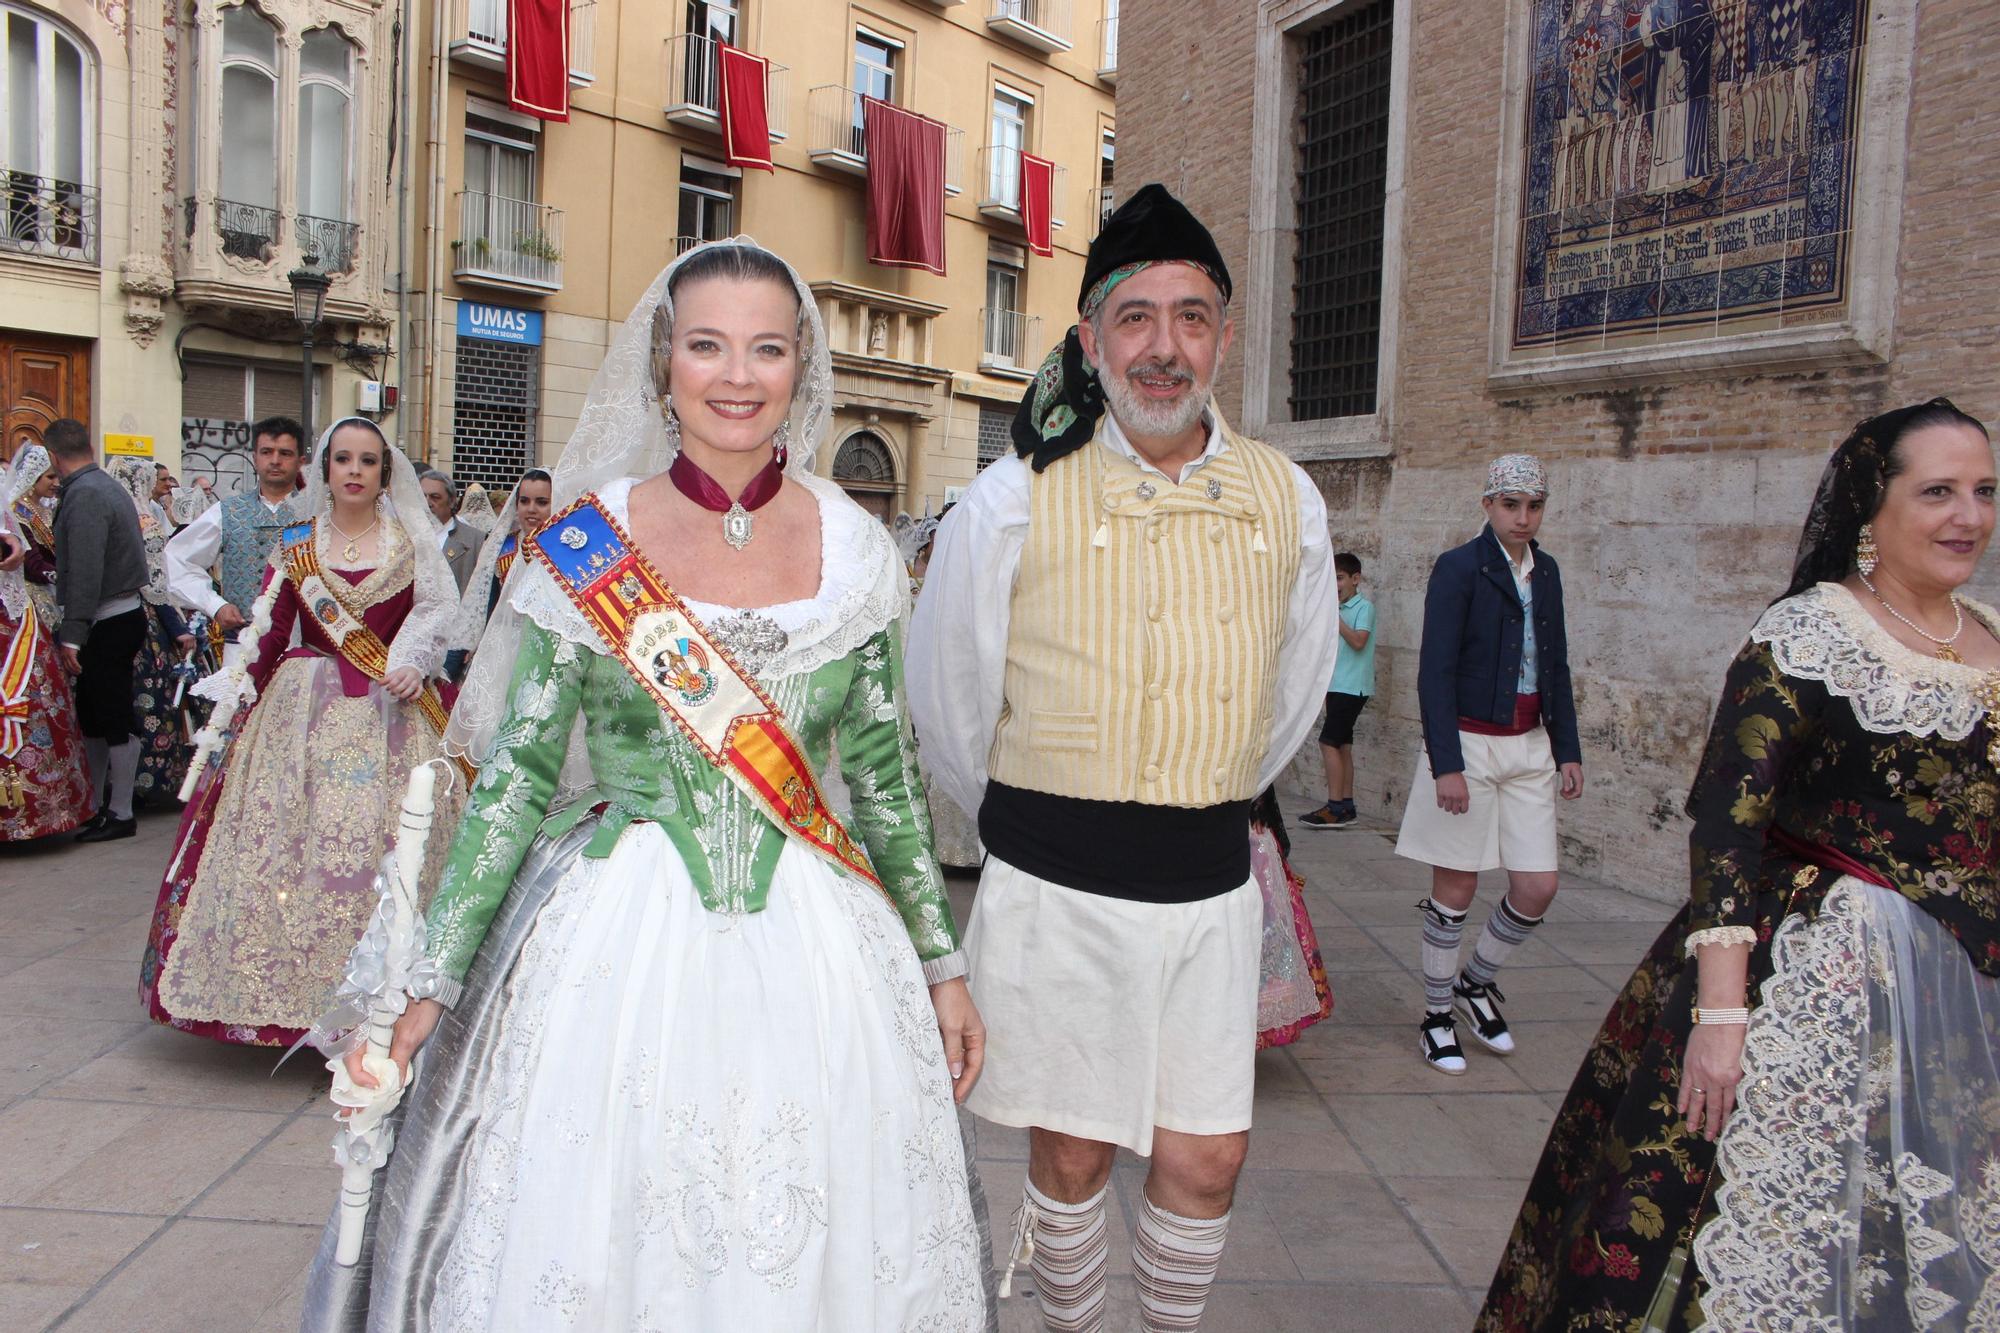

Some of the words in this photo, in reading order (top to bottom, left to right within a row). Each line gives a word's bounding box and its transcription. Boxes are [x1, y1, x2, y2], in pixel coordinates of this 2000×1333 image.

[470, 305, 527, 331] UMAS
[472, 327, 492, 336] MUTUA
[500, 331, 524, 340] SEGUROS
[636, 619, 678, 656] 2022
